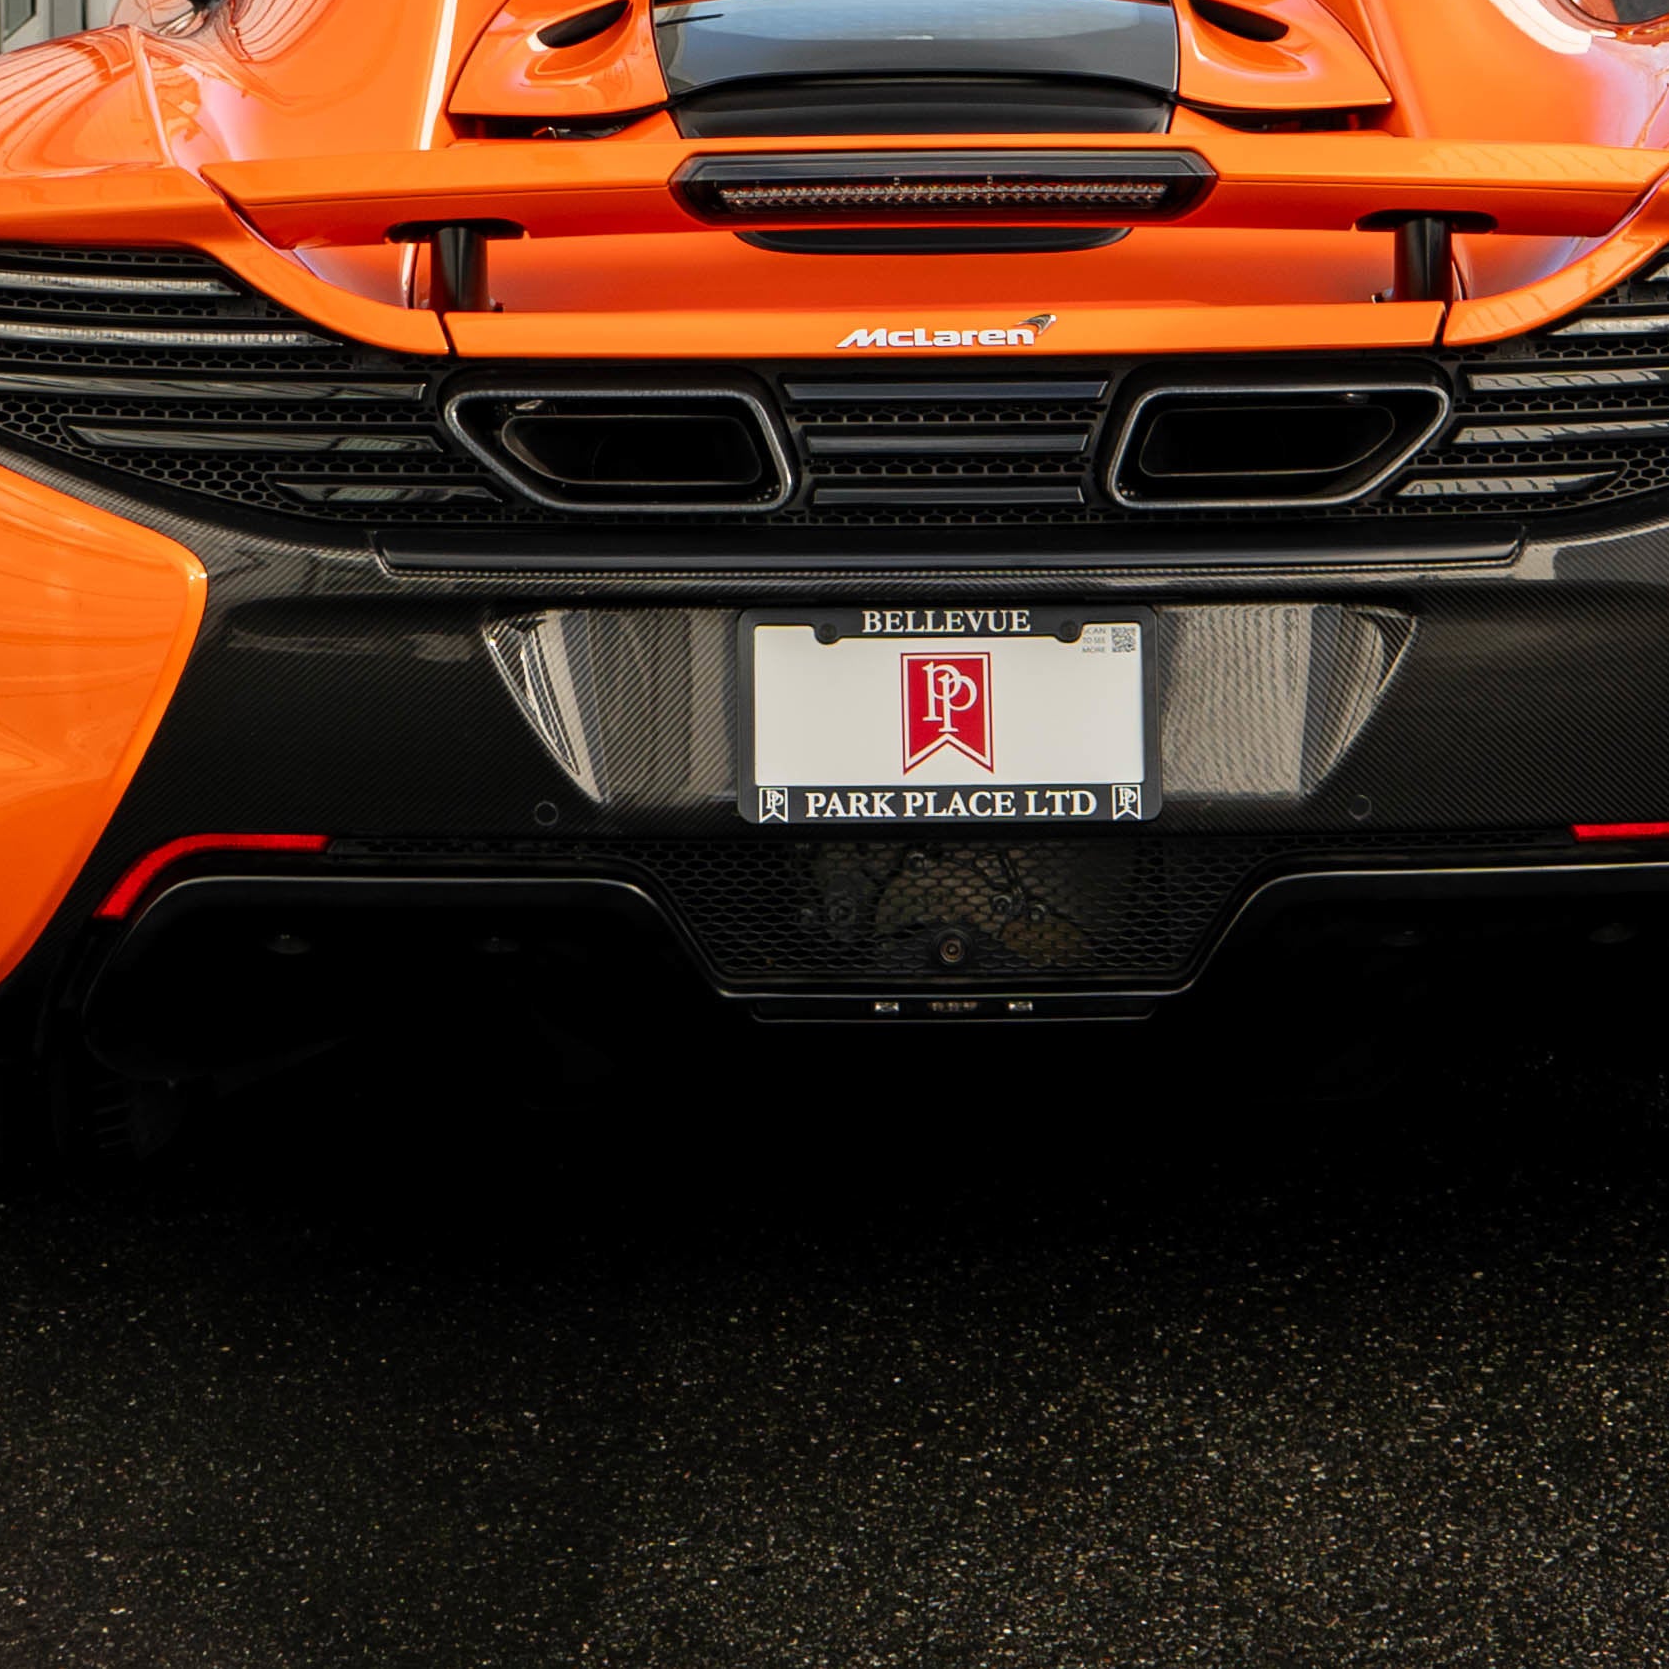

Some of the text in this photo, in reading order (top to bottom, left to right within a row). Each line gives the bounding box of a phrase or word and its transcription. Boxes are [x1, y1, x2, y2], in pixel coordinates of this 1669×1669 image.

[835, 327, 1035, 348] McLaren
[861, 609, 1032, 633] BELLEVUE
[805, 791, 1098, 818] PARK PLACE LTD
